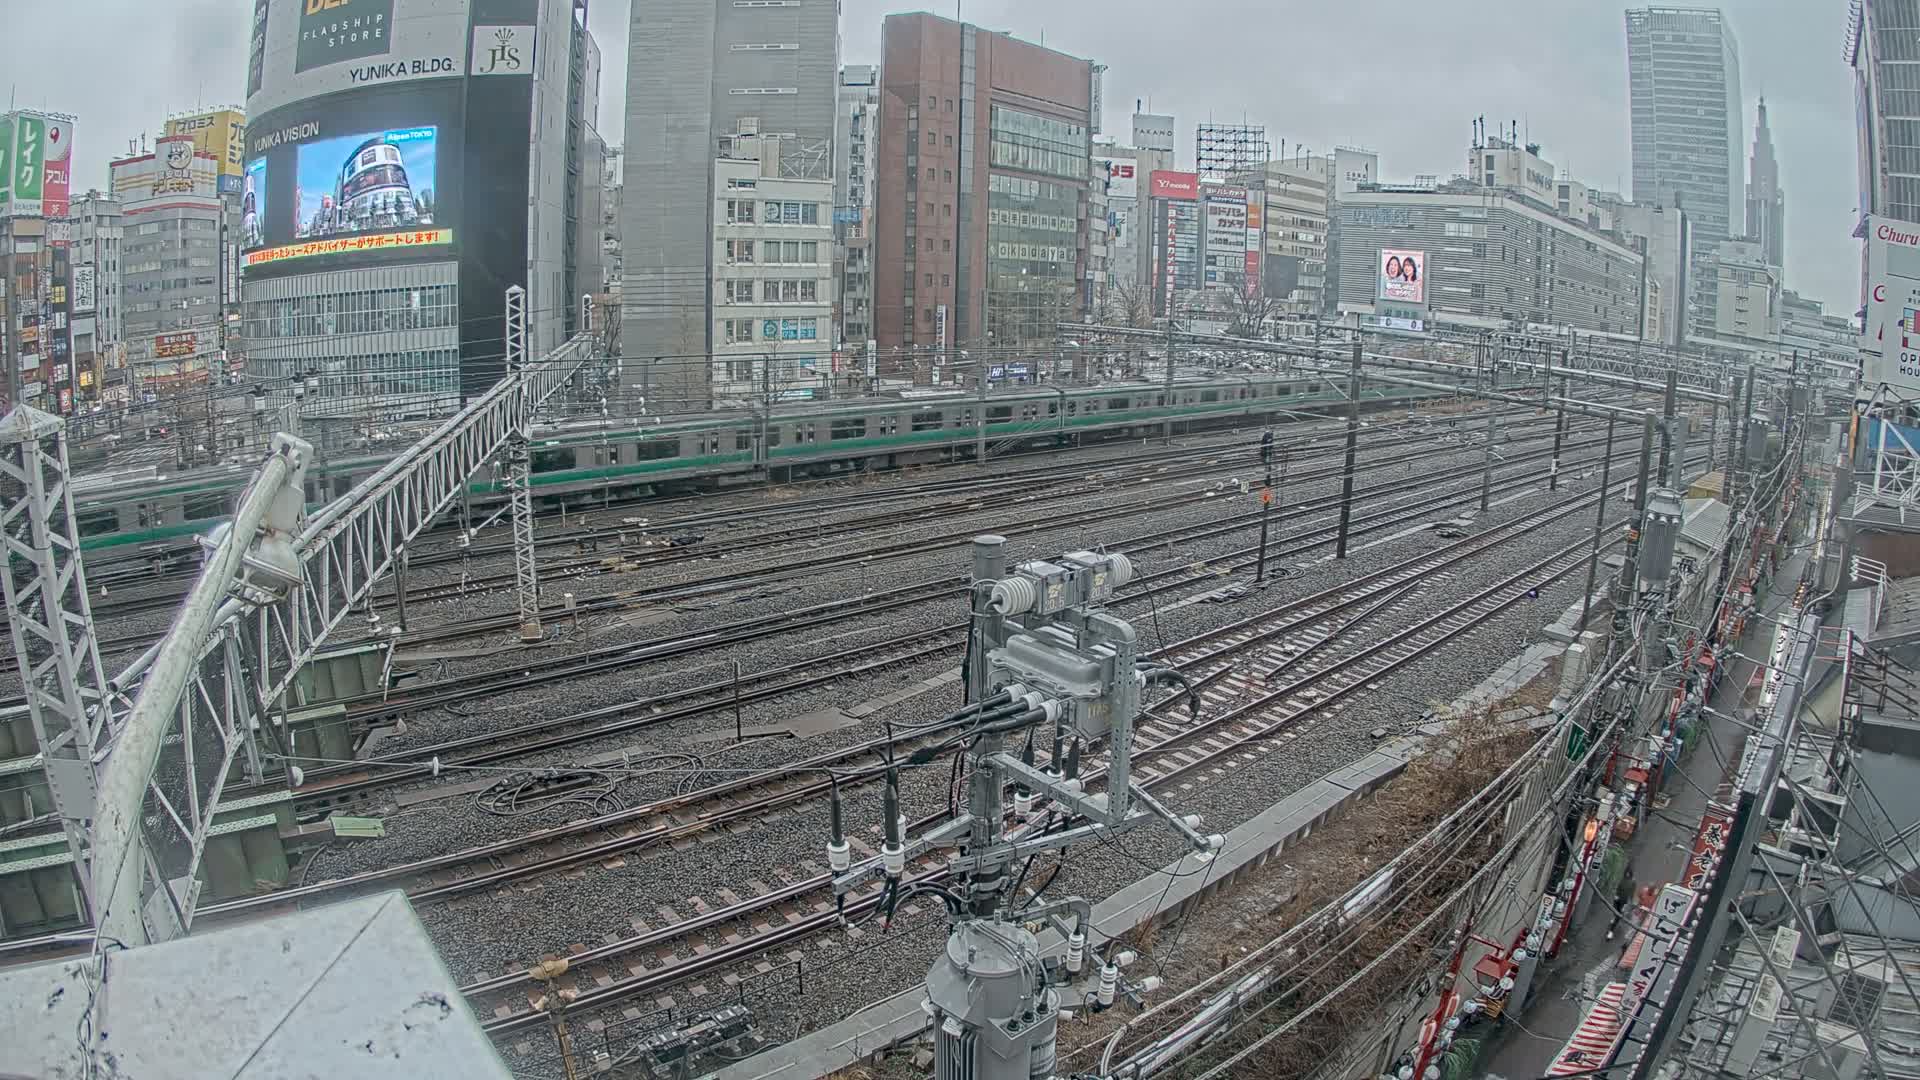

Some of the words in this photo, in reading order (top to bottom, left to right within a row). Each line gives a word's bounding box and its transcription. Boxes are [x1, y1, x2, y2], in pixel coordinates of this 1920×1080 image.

[304, 14, 383, 41] FLAGSHIP
[329, 28, 382, 47] STORE
[350, 62, 408, 83] YUNIKA
[411, 57, 456, 75] BLDG.
[176, 116, 215, 132] プロミス
[1134, 128, 1173, 137] TAKANO
[254, 131, 281, 152] YUNIKA
[282, 121, 320, 145] VISION
[21, 120, 37, 188] レイク
[46, 169, 69, 184] アコム
[1000, 246, 1065, 260] okadaya
[1900, 352, 1920, 366] OP
